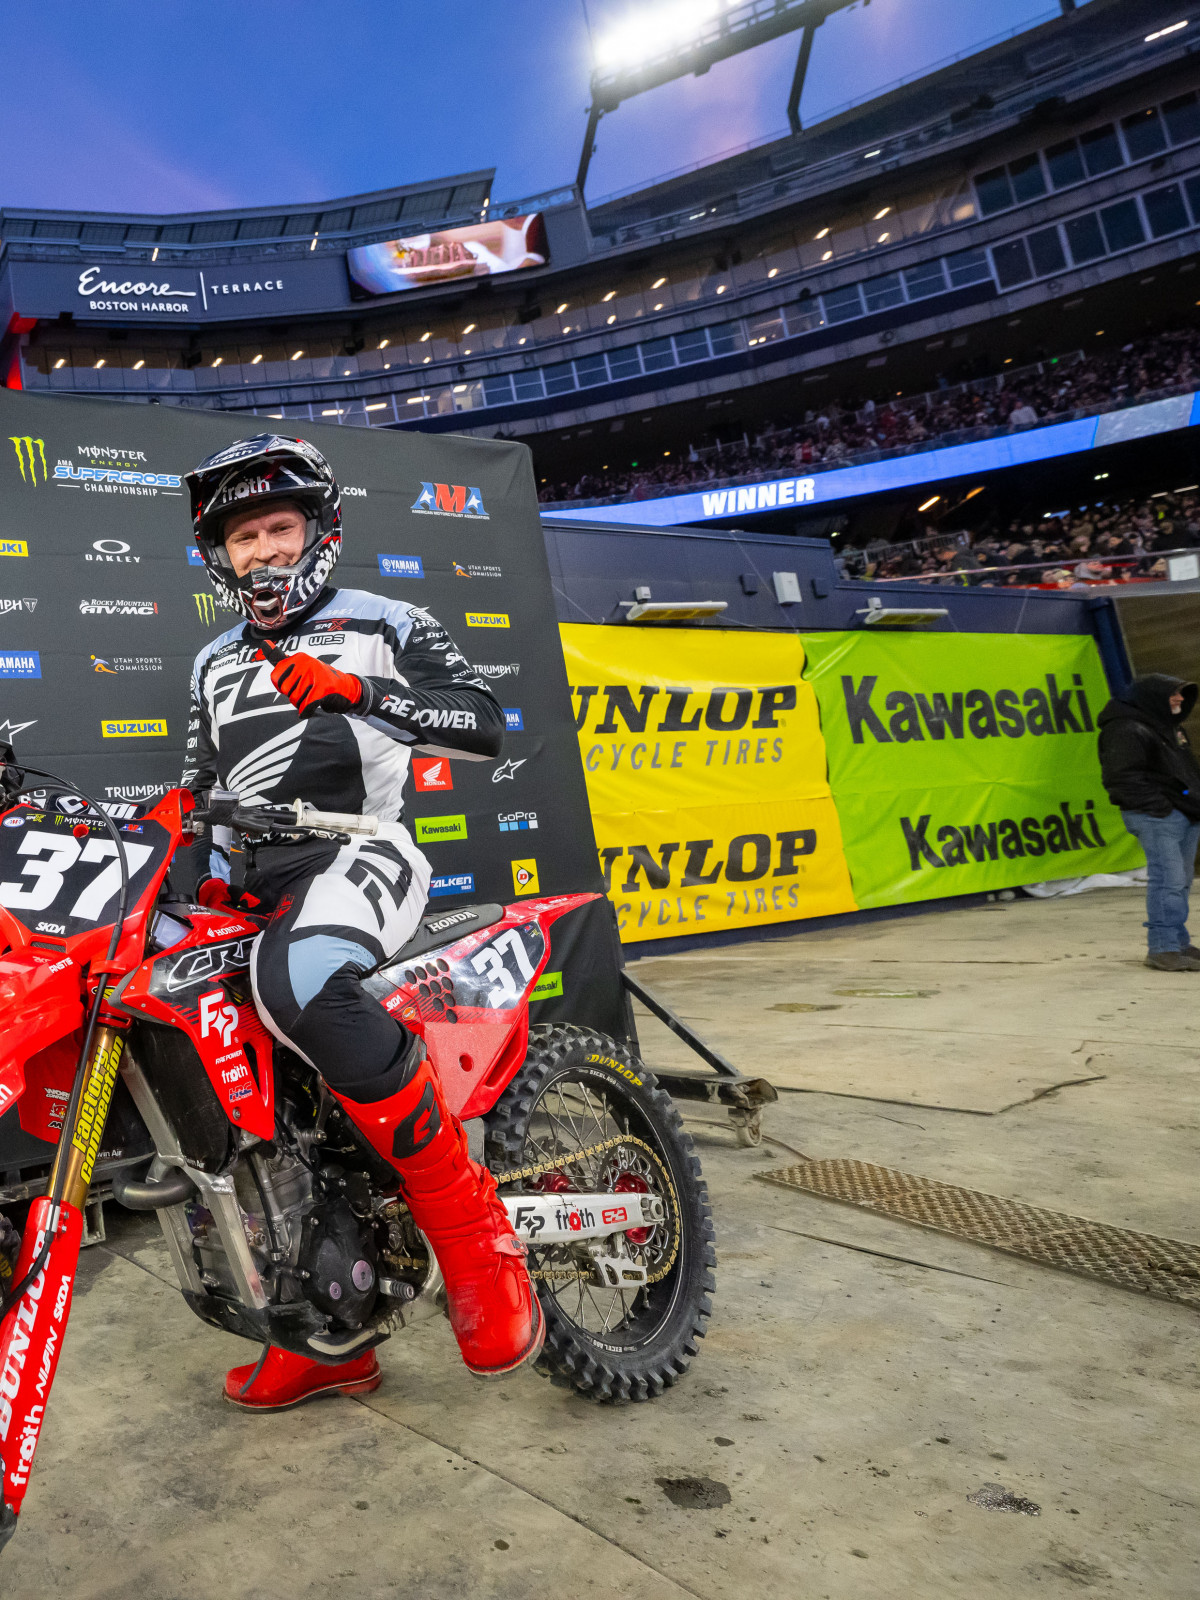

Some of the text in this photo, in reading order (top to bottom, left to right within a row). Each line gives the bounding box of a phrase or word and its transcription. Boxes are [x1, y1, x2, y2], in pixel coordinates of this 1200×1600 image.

[78, 266, 284, 297] Encore TERRACE
[90, 300, 189, 313] BOSTON HARBOR
[78, 445, 148, 462] MONSTER
[57, 459, 73, 467] AMA
[91, 459, 138, 468] ENERGY
[52, 465, 183, 488] SUPERCROSS
[84, 483, 158, 497] CHAMPIONSHIP
[222, 476, 270, 504] froth
[410, 481, 490, 516] AMA
[702, 478, 816, 517] WINNER
[85, 554, 141, 563] OAKLEY
[390, 559, 420, 571] YAMAHA
[91, 599, 153, 608] ROCKY MOUNTAIN
[313, 620, 349, 632] SMX
[468, 616, 506, 625] SUZUKI
[308, 634, 346, 646] WPS
[473, 664, 512, 678] TRIUMPH
[841, 672, 1096, 745] Kawasaki
[106, 722, 163, 735] SUZUKI
[705, 737, 783, 766] TIRES
[105, 784, 165, 801] TRIUMPH
[498, 811, 537, 822] GoPro
[309, 829, 338, 841] ASV
[421, 823, 462, 835] Kawasaki
[901, 800, 1107, 872] Kawasaki
[725, 884, 800, 918] TIRES
[35, 921, 66, 935] SKDA
[429, 911, 478, 931] HONDA
[214, 924, 246, 937] HONDA
[48, 957, 74, 974] ANSTIE
[470, 928, 536, 1010] 37
[386, 995, 404, 1012] SKDA
[221, 1063, 249, 1084] froth
[589, 1054, 643, 1087] DUNLOP
[71, 1046, 110, 1153] Factory
[556, 1206, 595, 1232] froth
[53, 1274, 71, 1322] SKDA
[37, 1325, 58, 1399] NISSIN
[9, 1403, 44, 1488] froth
